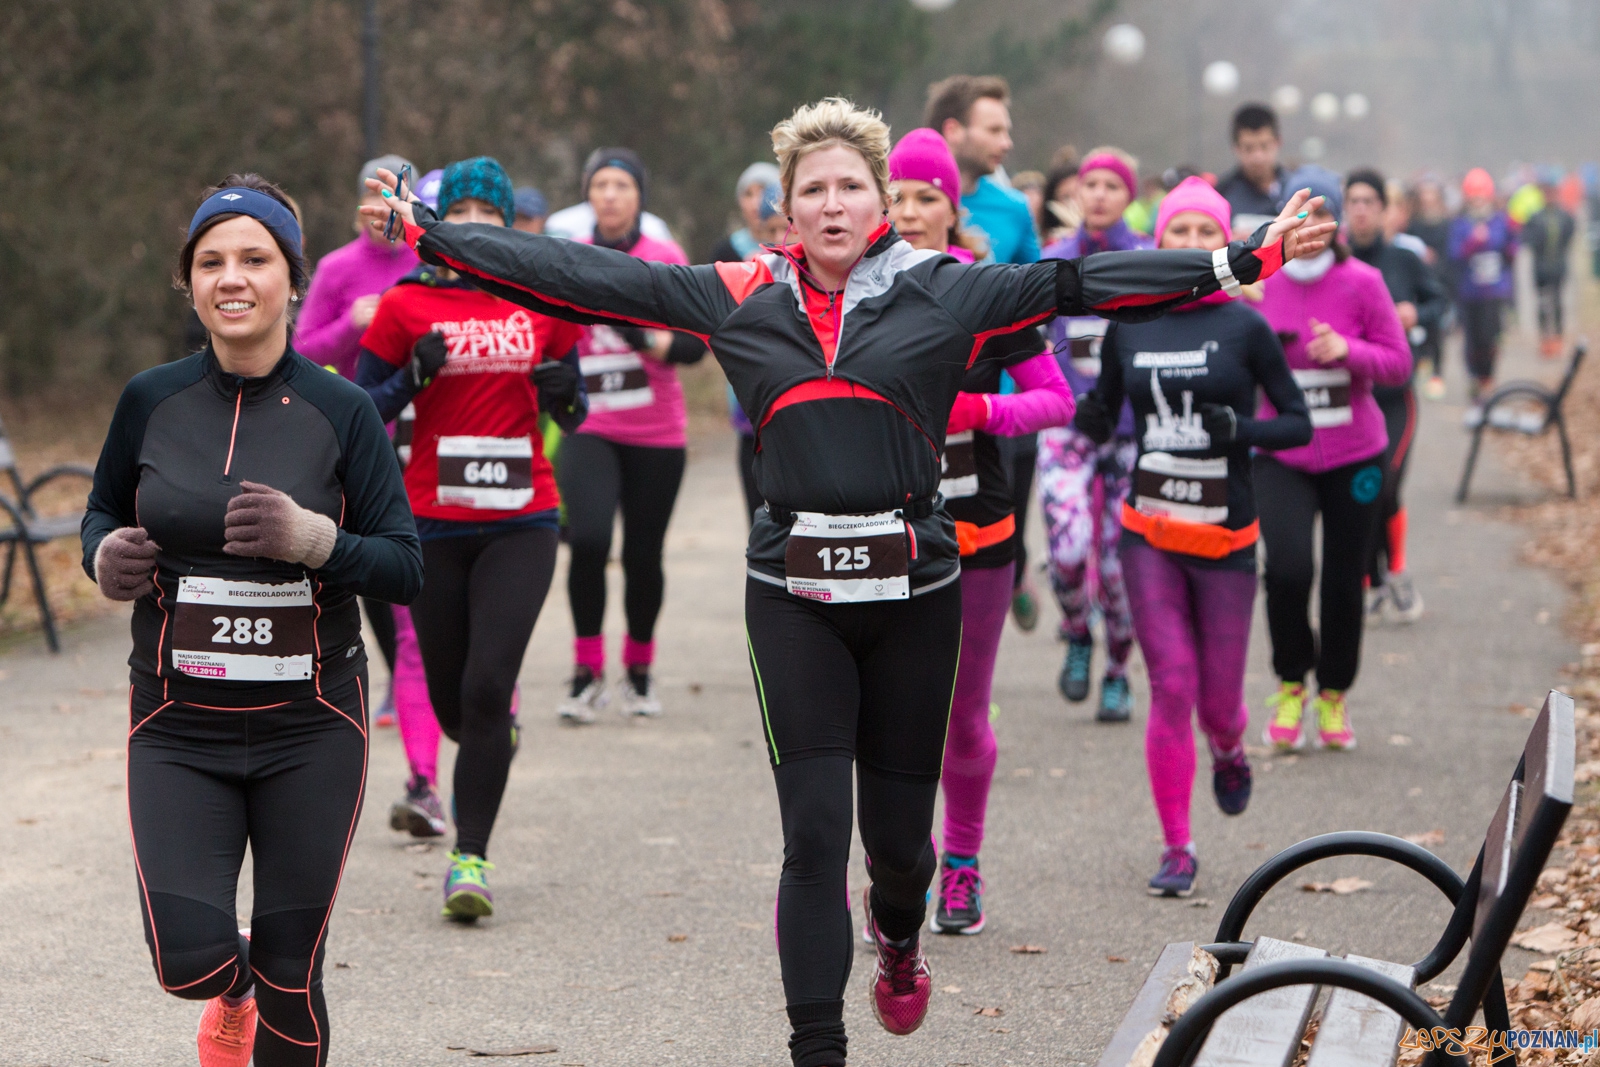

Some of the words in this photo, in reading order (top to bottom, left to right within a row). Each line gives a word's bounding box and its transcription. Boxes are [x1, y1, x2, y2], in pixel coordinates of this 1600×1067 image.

[464, 461, 508, 484] 640
[1160, 479, 1202, 502] 498
[828, 519, 898, 530] BIEGCZEKOLADOWY.PL
[817, 546, 871, 572] 125
[228, 589, 307, 598] BIEGCZEKOLADOWY.PL
[211, 616, 273, 645] 288
